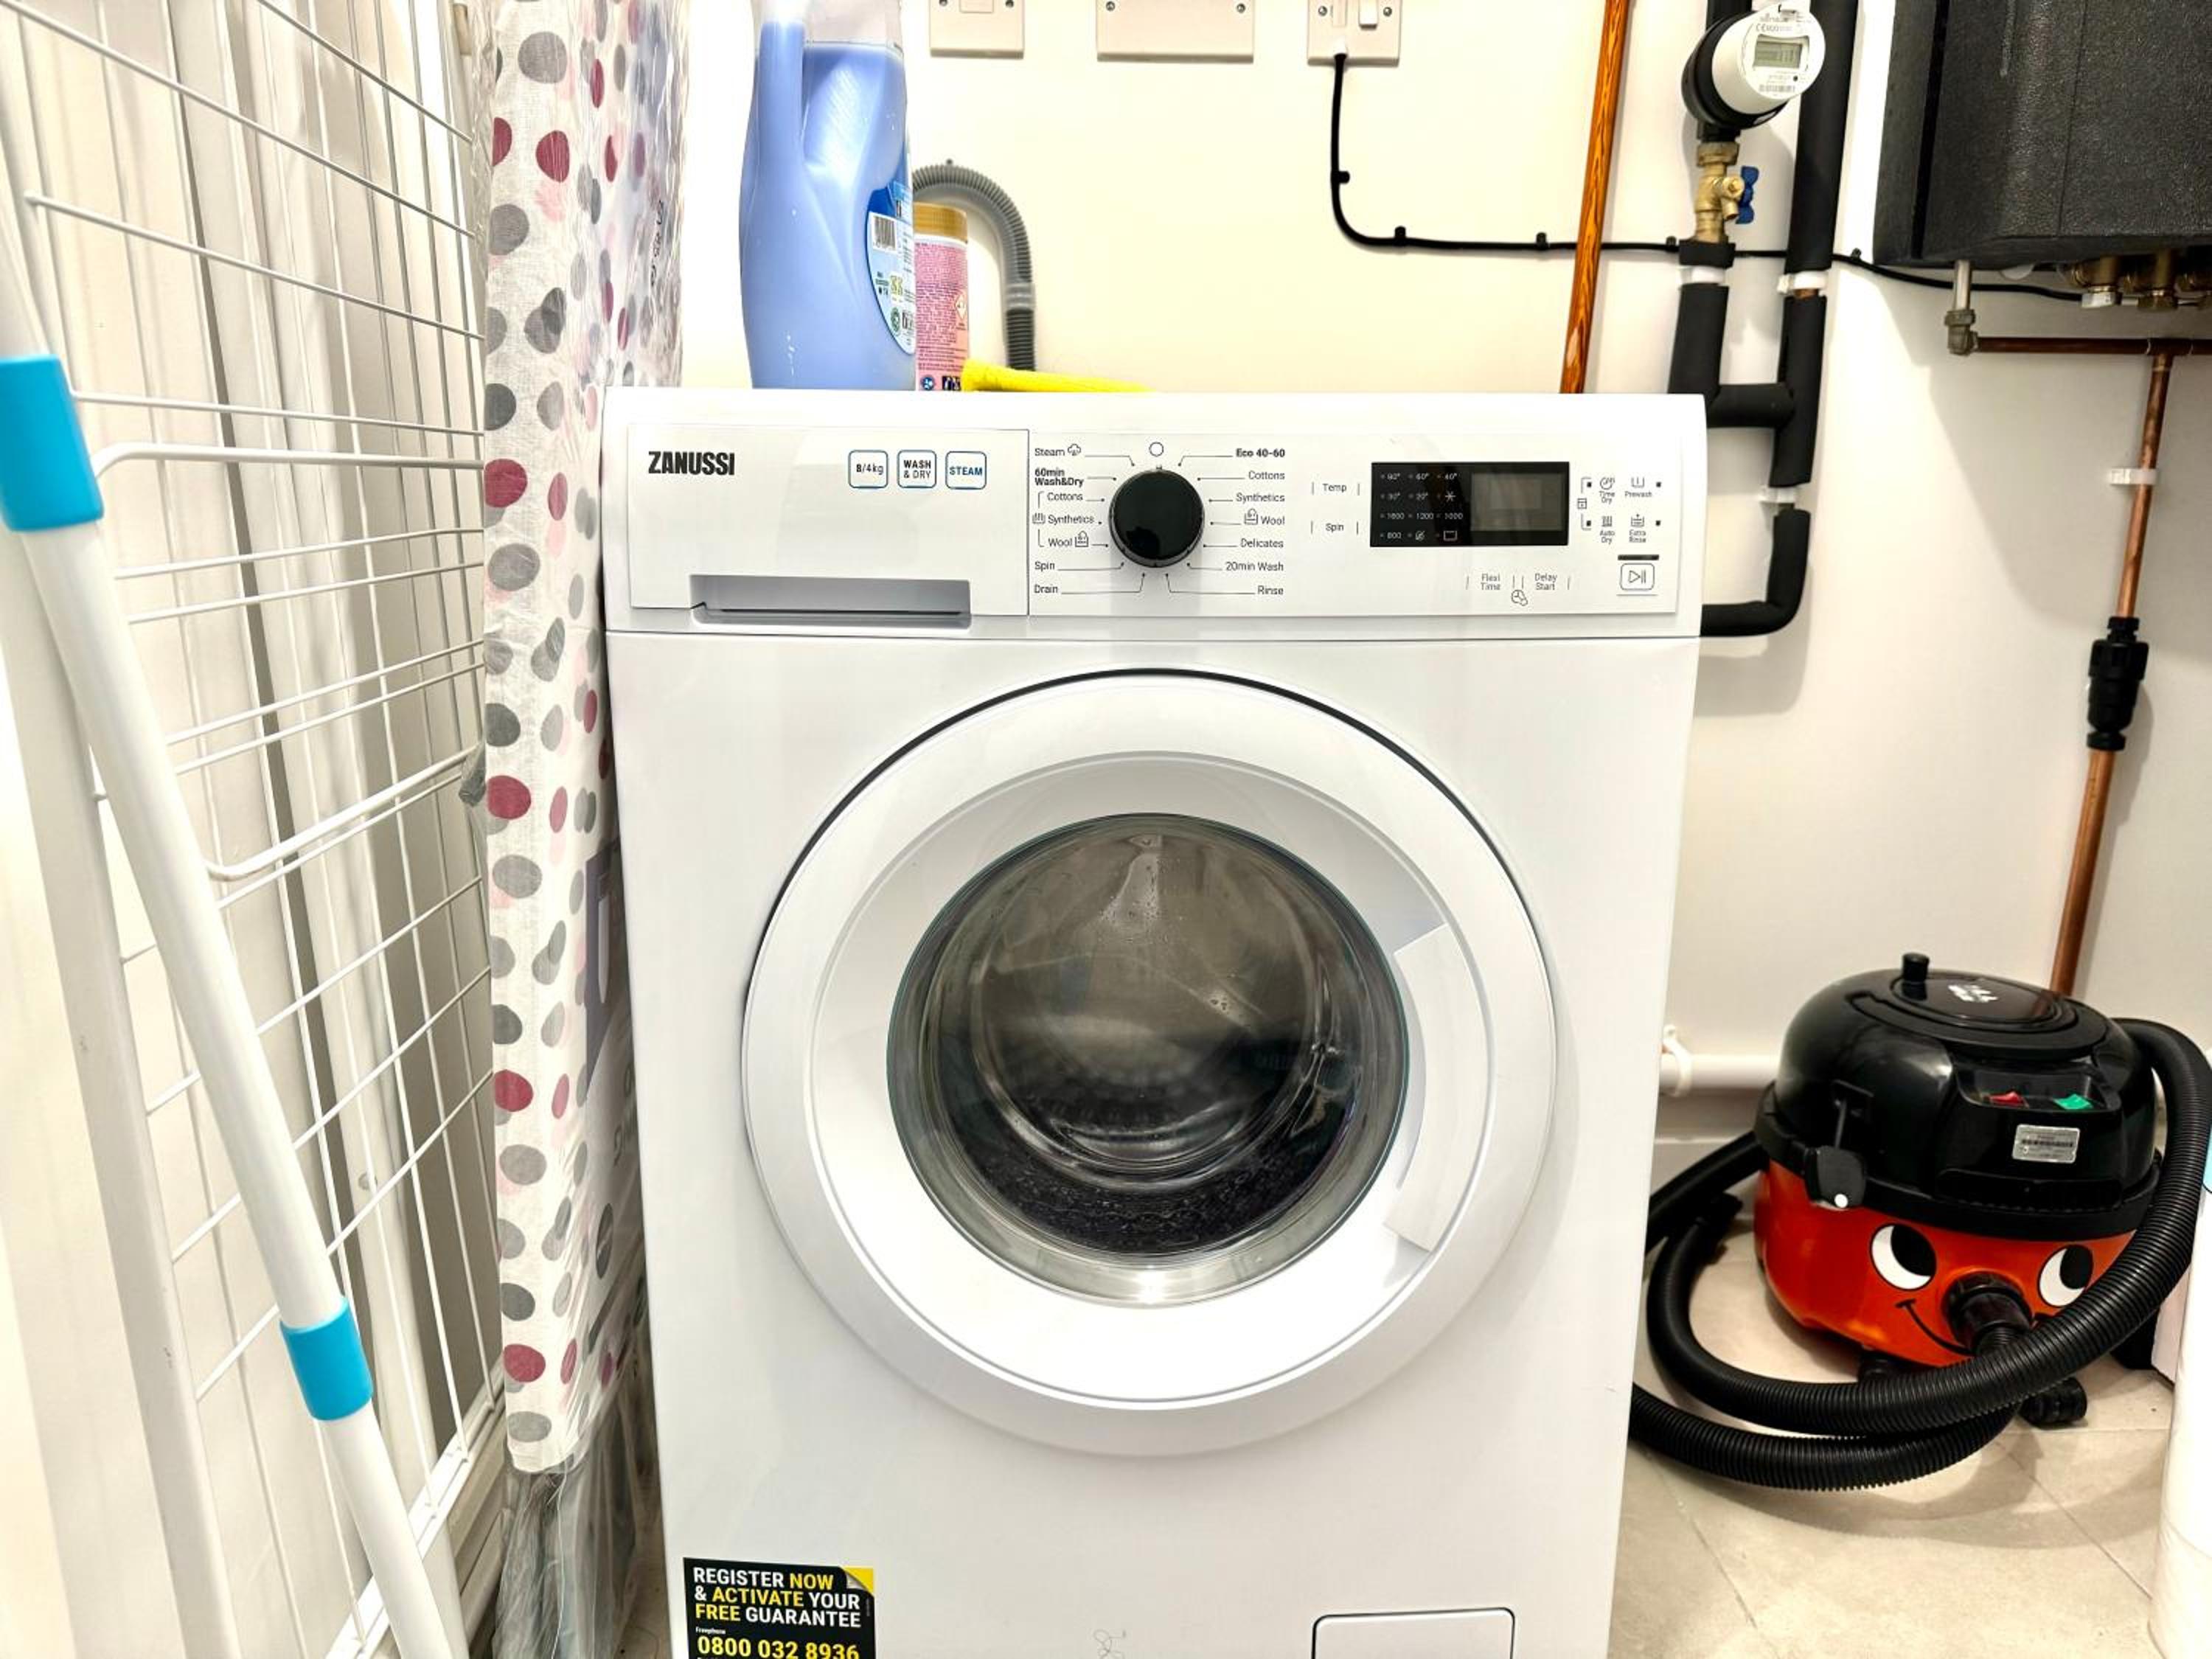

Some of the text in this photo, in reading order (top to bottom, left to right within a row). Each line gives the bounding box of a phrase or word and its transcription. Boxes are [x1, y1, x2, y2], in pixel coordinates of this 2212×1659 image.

[1034, 448, 1065, 456] Steam
[1236, 448, 1285, 457] Eco 40-60
[648, 451, 735, 476] ZANUSSI
[903, 460, 931, 469] WASH
[856, 462, 884, 475] 8/4kg
[950, 467, 983, 476] STEAM
[1034, 467, 1065, 476] 60min
[903, 470, 931, 479] & DRY
[1248, 470, 1285, 480] Cottons
[1034, 478, 1084, 487] Wash&Dry
[1322, 484, 1347, 493] Temp
[1047, 493, 1083, 501] Cottons
[1236, 493, 1285, 504] Synthetics
[1048, 515, 1094, 526] Synthetics
[1260, 516, 1285, 525] Wool
[1326, 524, 1344, 532] Spin
[1048, 538, 1072, 546] Wool
[1240, 538, 1284, 548] Delicates
[1601, 537, 1613, 545] Dry
[1034, 561, 1055, 571] Spin
[1225, 562, 1284, 571] 20min Wash
[1534, 573, 1557, 582] Delay
[1034, 585, 1058, 594] Drain
[1257, 585, 1284, 595] Rinse
[1481, 582, 1500, 591] Time
[1536, 582, 1555, 591] Start
[693, 1567, 833, 1590] REGISTER NOW
[694, 1586, 707, 1601] &
[712, 1587, 804, 1607] ACTIVATE
[809, 1592, 860, 1610] YOUR
[695, 1604, 861, 1628] FREE GUARANTEE
[698, 1635, 859, 1659] 0800 032 8936
